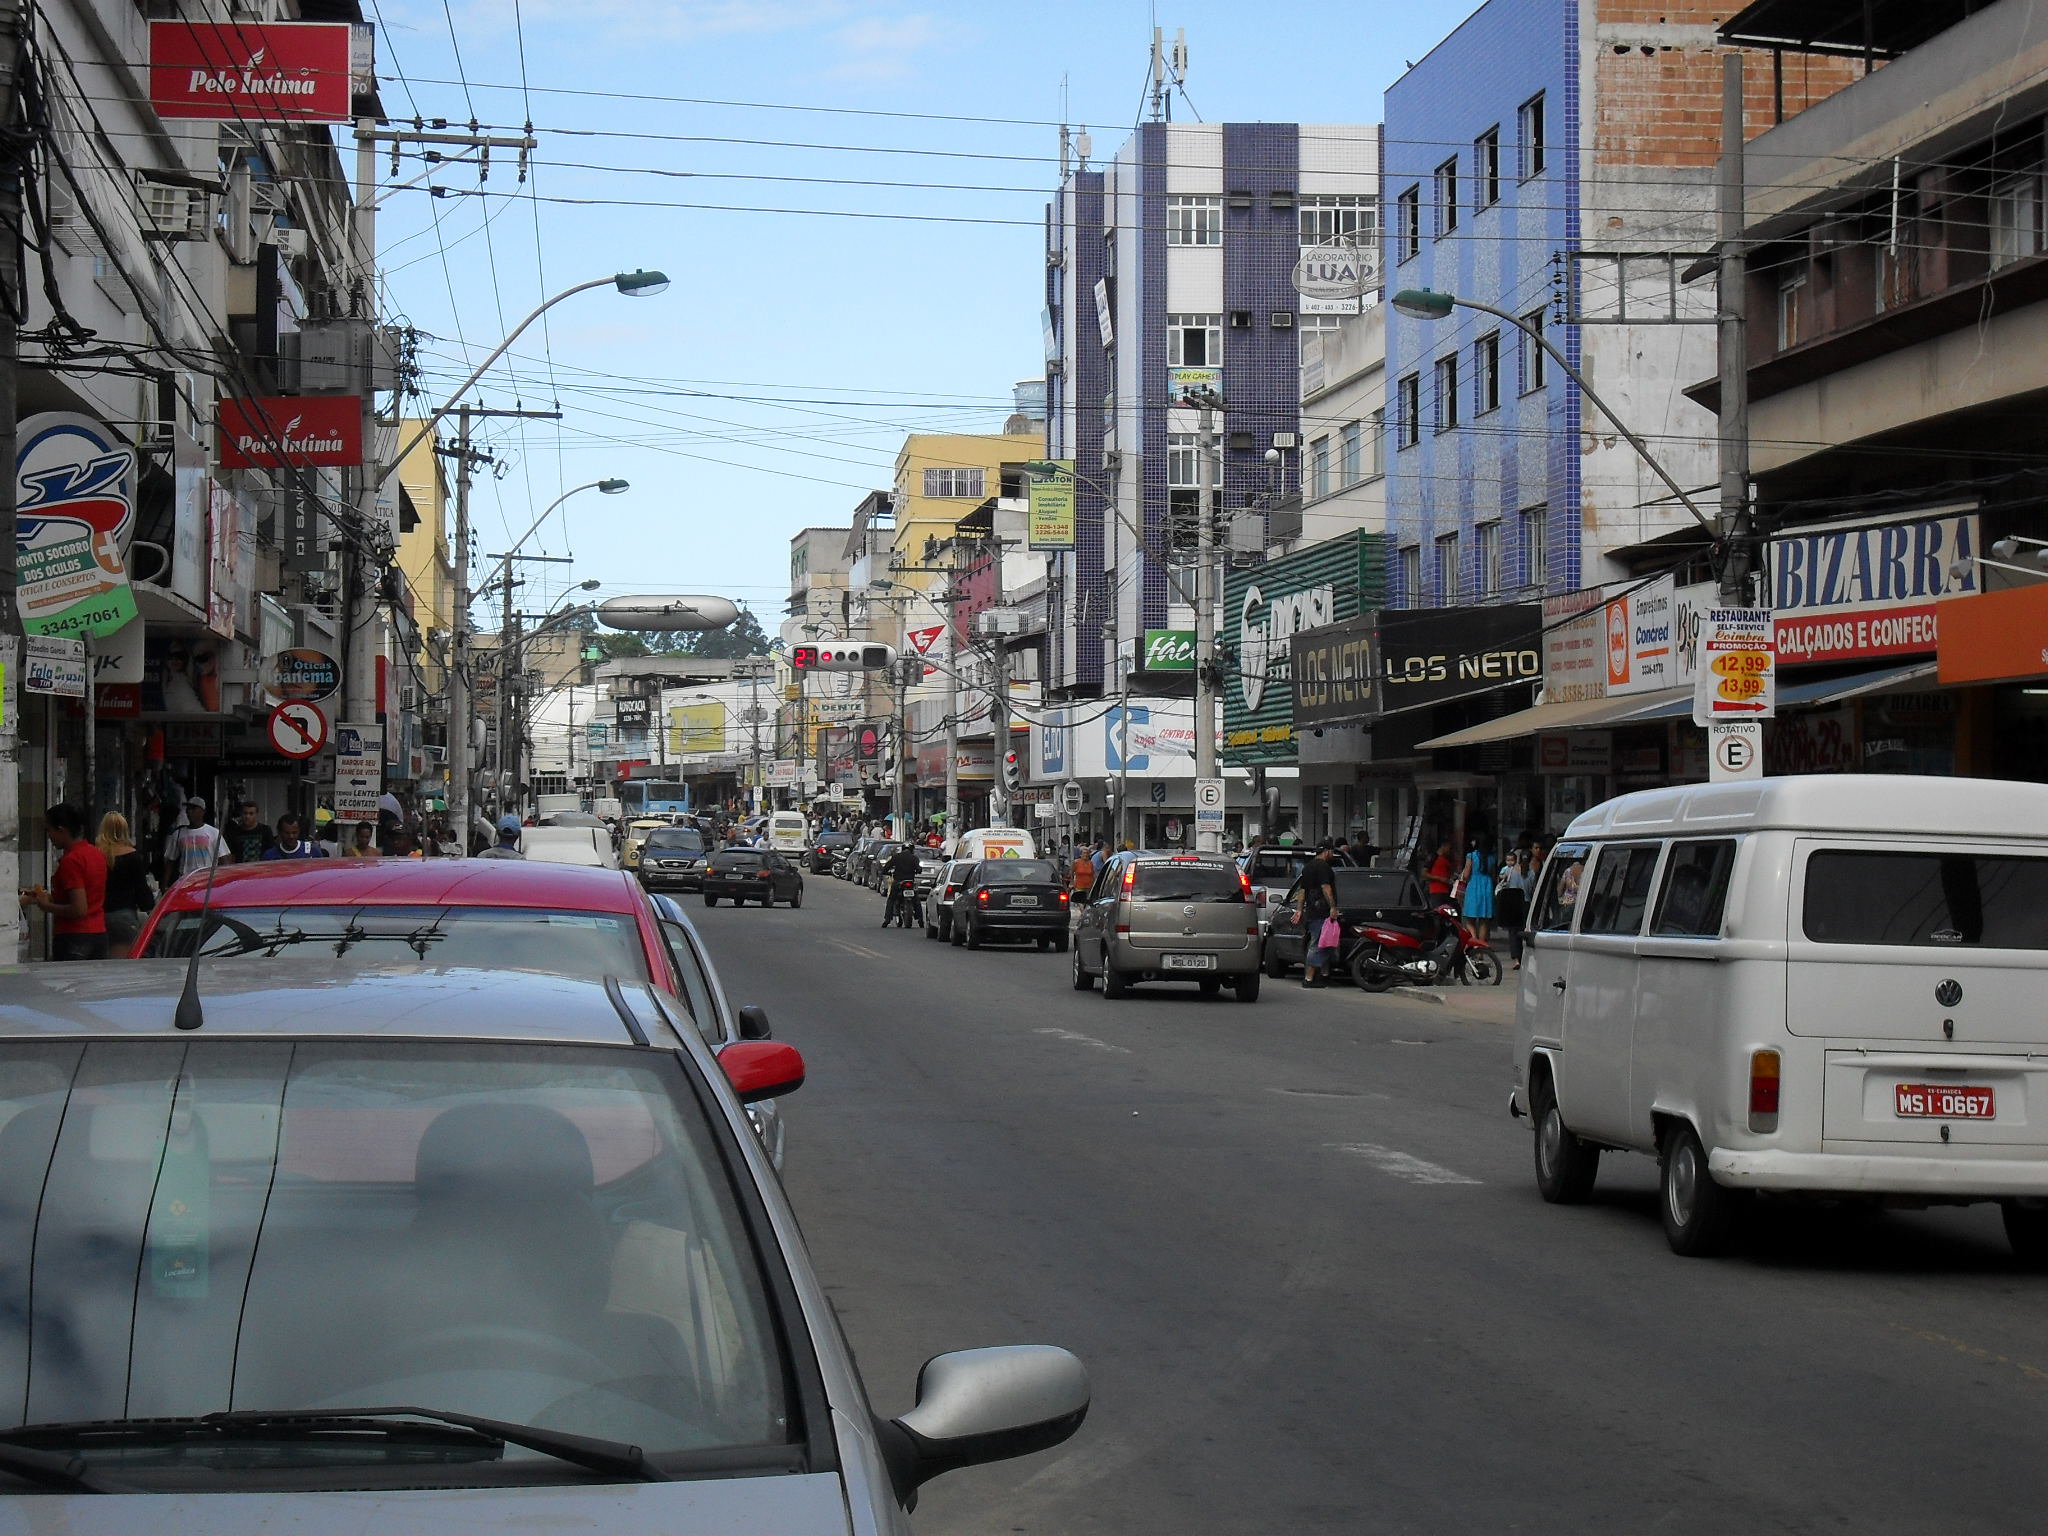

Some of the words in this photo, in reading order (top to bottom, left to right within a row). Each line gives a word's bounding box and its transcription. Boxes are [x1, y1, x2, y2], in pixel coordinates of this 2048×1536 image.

[188, 70, 237, 93] Pele
[1174, 372, 1190, 381] PLAY
[1192, 372, 1216, 381] GAMES
[16, 554, 45, 569] RONTO
[46, 539, 90, 560] SOCORRO
[1774, 516, 1977, 611] BIZARRA
[24, 569, 44, 582] DOS
[40, 606, 120, 636] 3343-7061
[1710, 610, 1771, 623] RESTAURANTE
[1636, 621, 1669, 646] Concred
[1715, 630, 1766, 642] Coimbra
[1777, 622, 1854, 659] CALÇADOS
[1858, 621, 1867, 647] E
[1712, 642, 1768, 651] PROMOÇÃO
[30, 662, 53, 680] Fala
[1298, 648, 1328, 708] LOS
[1332, 639, 1372, 705] NETO
[1386, 655, 1447, 684] LOS
[1458, 650, 1540, 680] NETO
[1718, 656, 1765, 674] 12,99
[1721, 679, 1760, 696] 13,99
[618, 700, 646, 712] ADVOCACIA
[1159, 728, 1184, 738] CENTRO
[1713, 726, 1756, 734] ROTATIVO
[1728, 744, 1743, 766] E
[353, 789, 380, 798] LENTES
[1206, 790, 1214, 802] E
[348, 800, 376, 808] CONTATO
